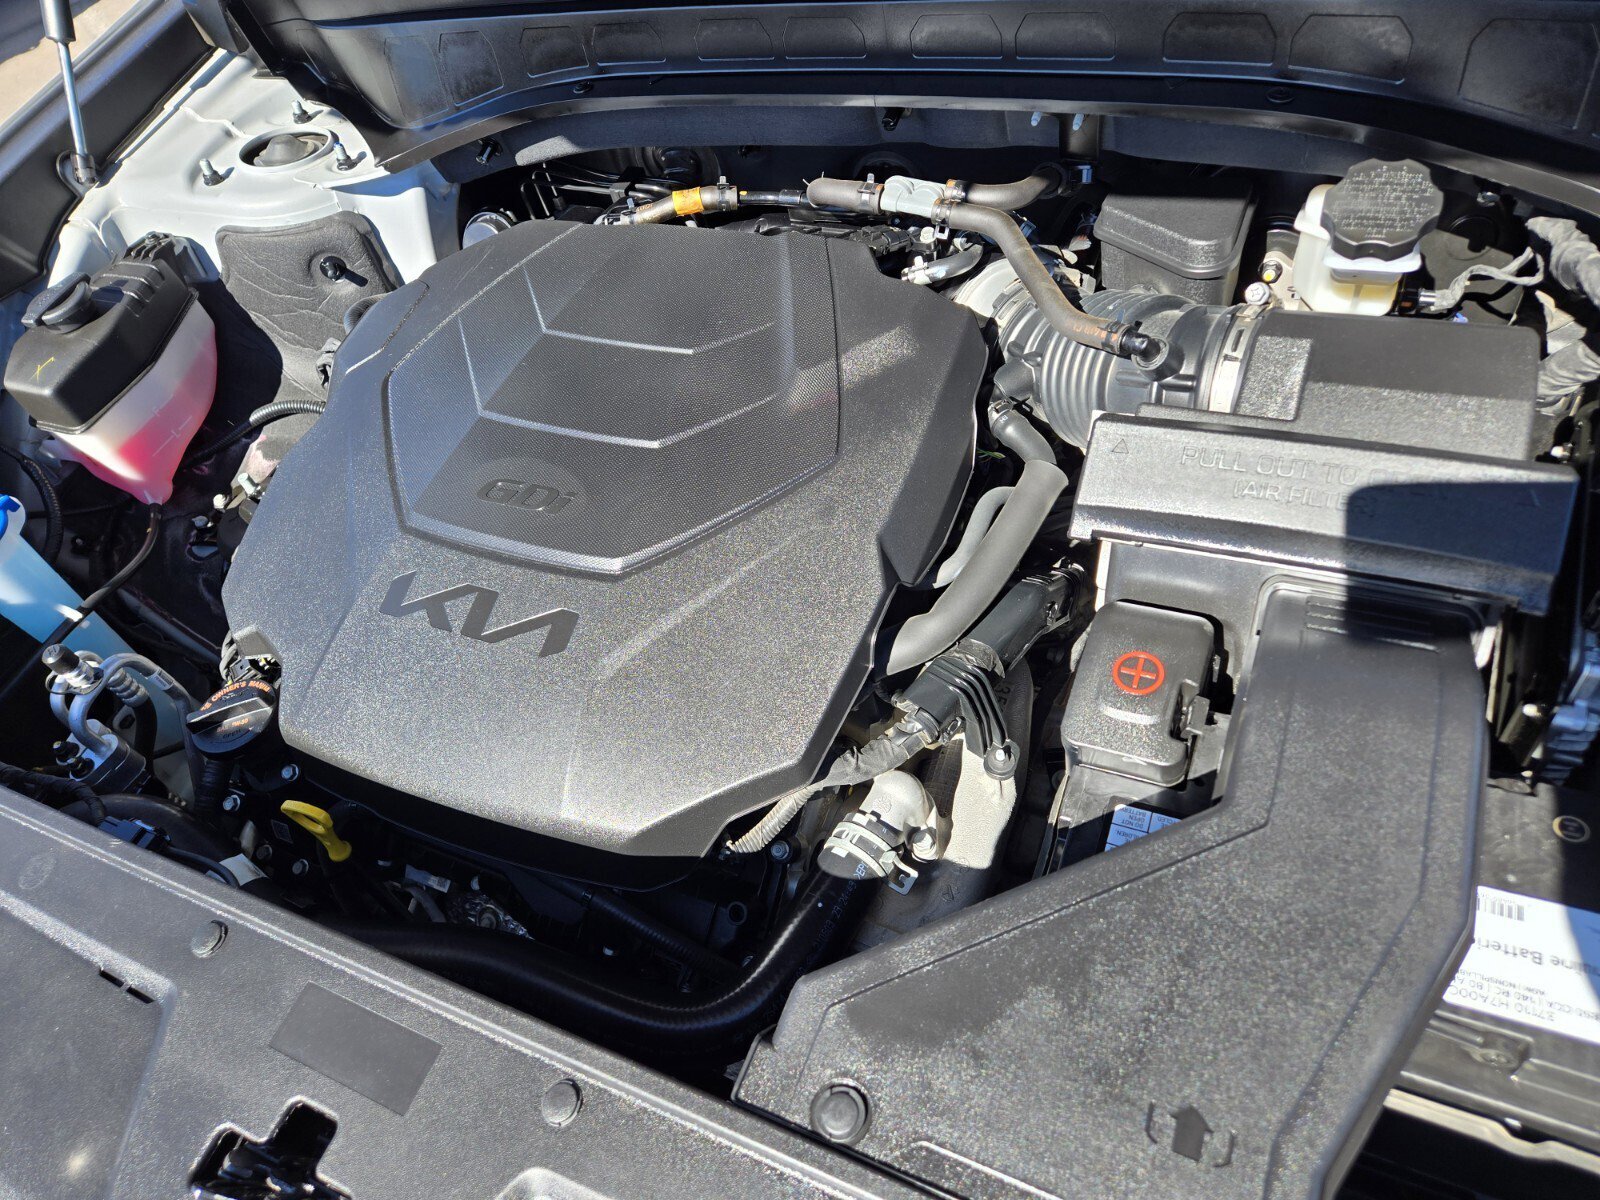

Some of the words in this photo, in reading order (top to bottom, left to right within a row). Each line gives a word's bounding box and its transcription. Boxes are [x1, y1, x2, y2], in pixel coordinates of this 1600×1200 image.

[1180, 445, 1247, 473] PULL
[1256, 454, 1315, 480] OUT
[1322, 462, 1360, 486] TO
[476, 478, 579, 515] GDi
[380, 570, 579, 658] KIA
[211, 681, 246, 701] OWNER'S
